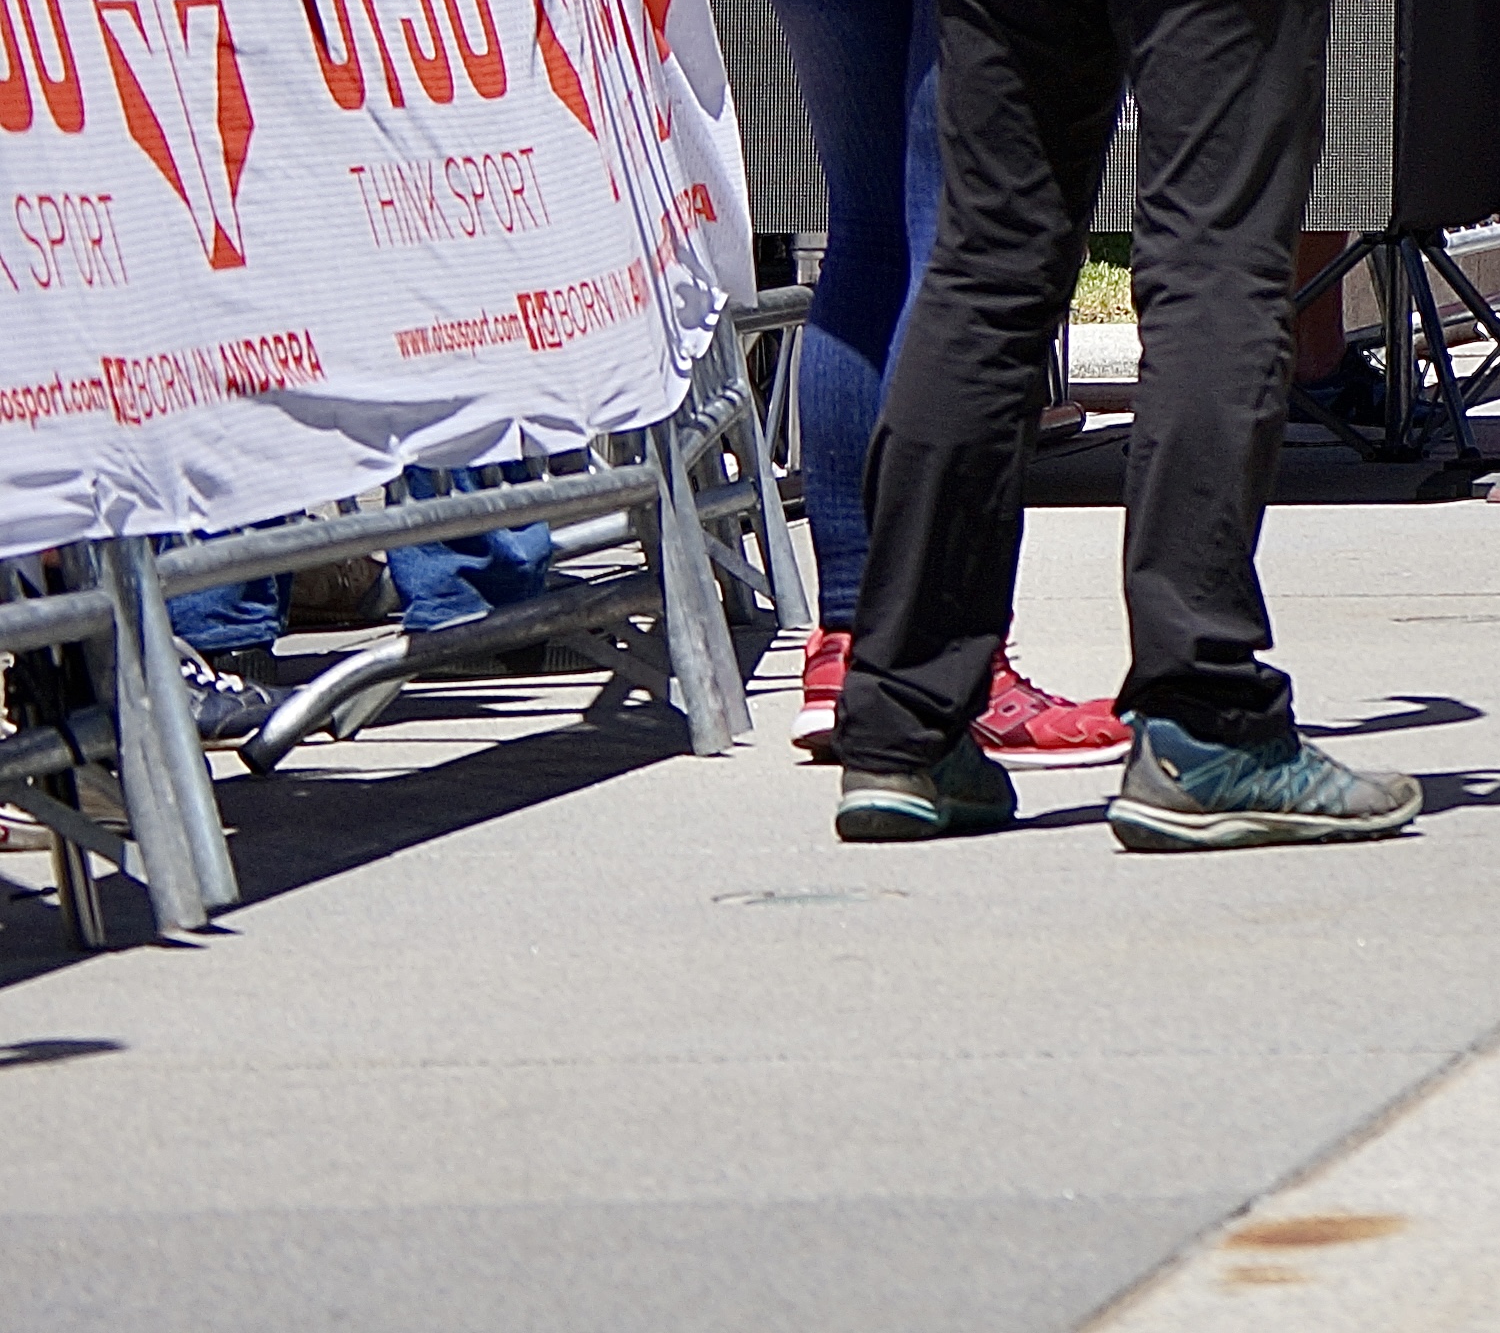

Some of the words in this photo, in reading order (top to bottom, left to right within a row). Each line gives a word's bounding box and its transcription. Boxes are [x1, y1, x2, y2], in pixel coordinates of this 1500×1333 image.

[15, 193, 129, 289] SPORT
[350, 162, 453, 249] THINK
[444, 147, 551, 239] SPORT
[0, 370, 109, 432] osport.com
[131, 351, 198, 420] BORN
[219, 327, 329, 402] ANDORRA
